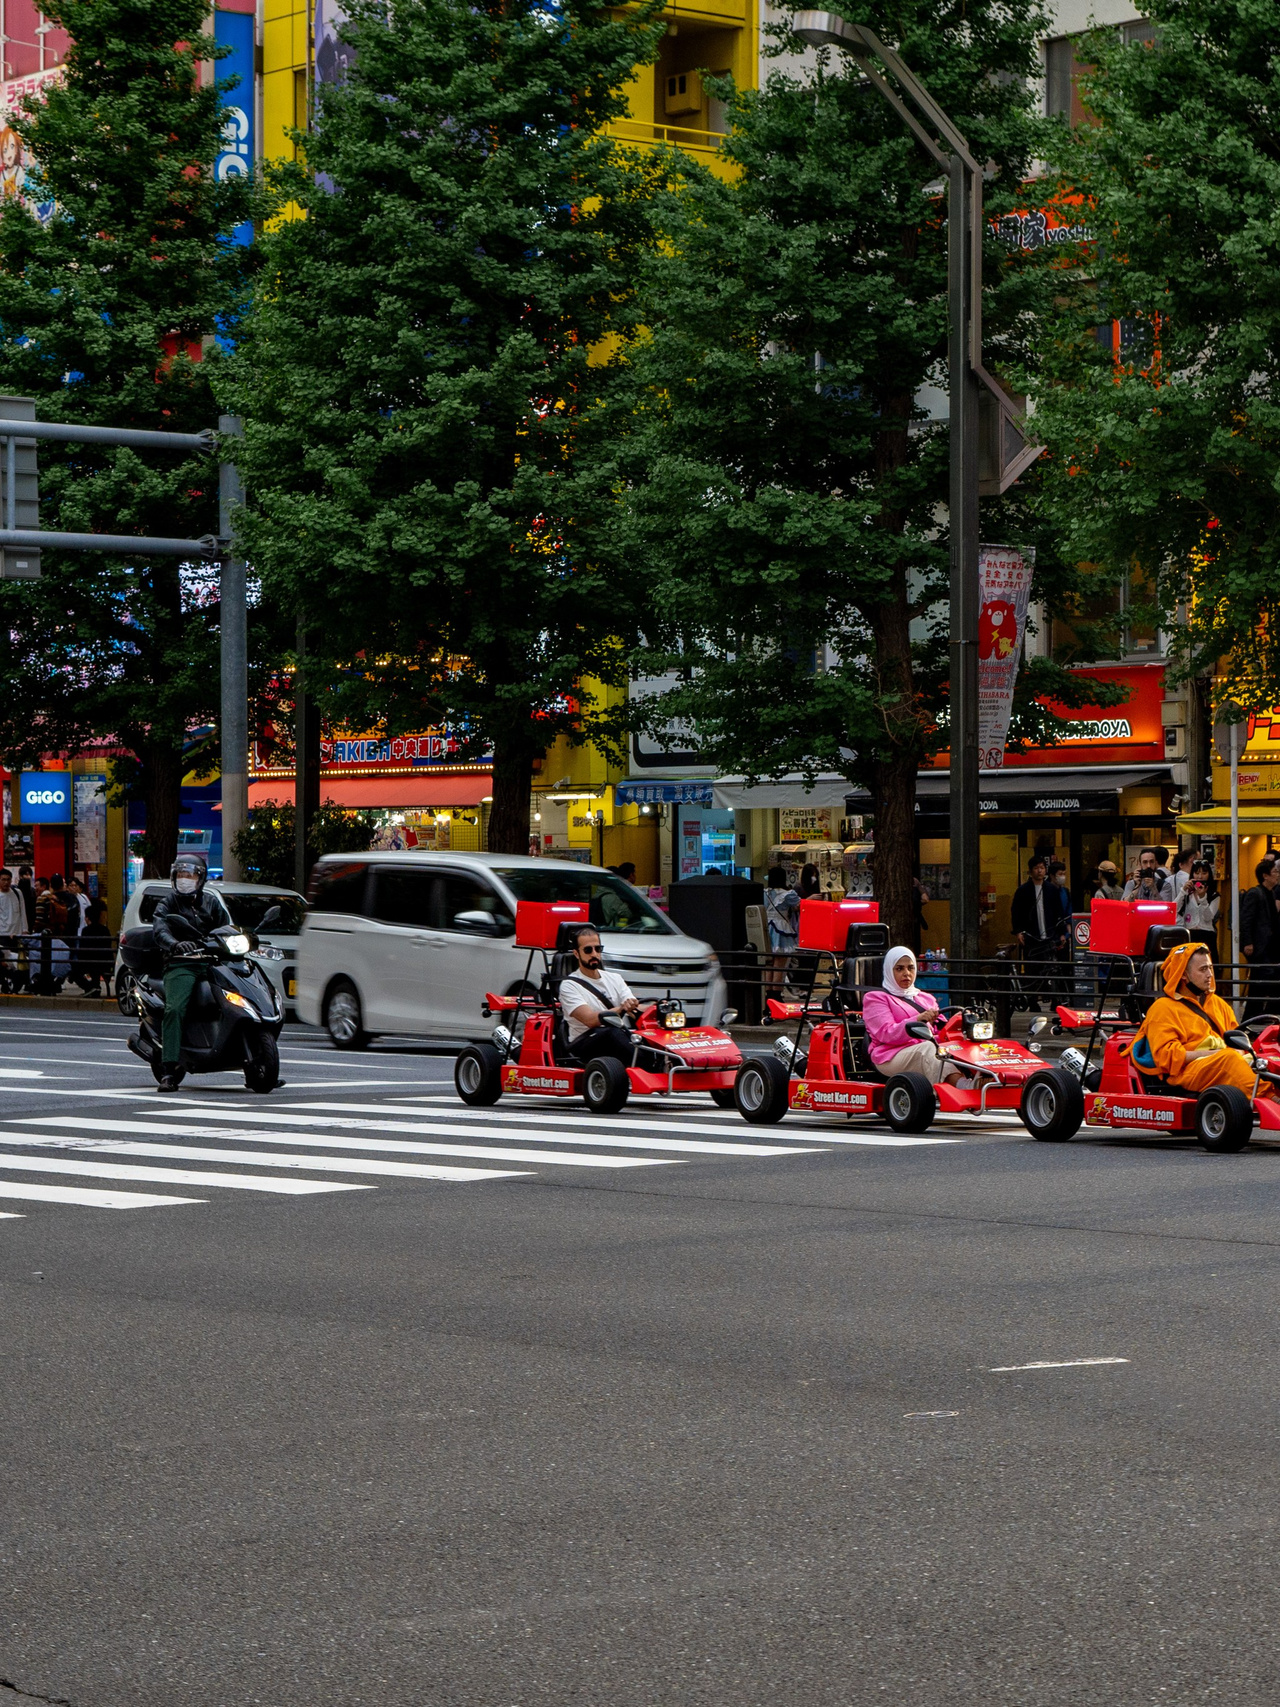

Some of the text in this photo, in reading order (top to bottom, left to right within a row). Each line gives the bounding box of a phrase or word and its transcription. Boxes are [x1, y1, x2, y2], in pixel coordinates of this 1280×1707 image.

[985, 570, 1024, 580] 安全・安心
[984, 579, 1022, 589] 元気なアキバ
[26, 790, 65, 804] GiGO
[814, 1090, 834, 1103] Street
[1112, 1105, 1136, 1119] Street
